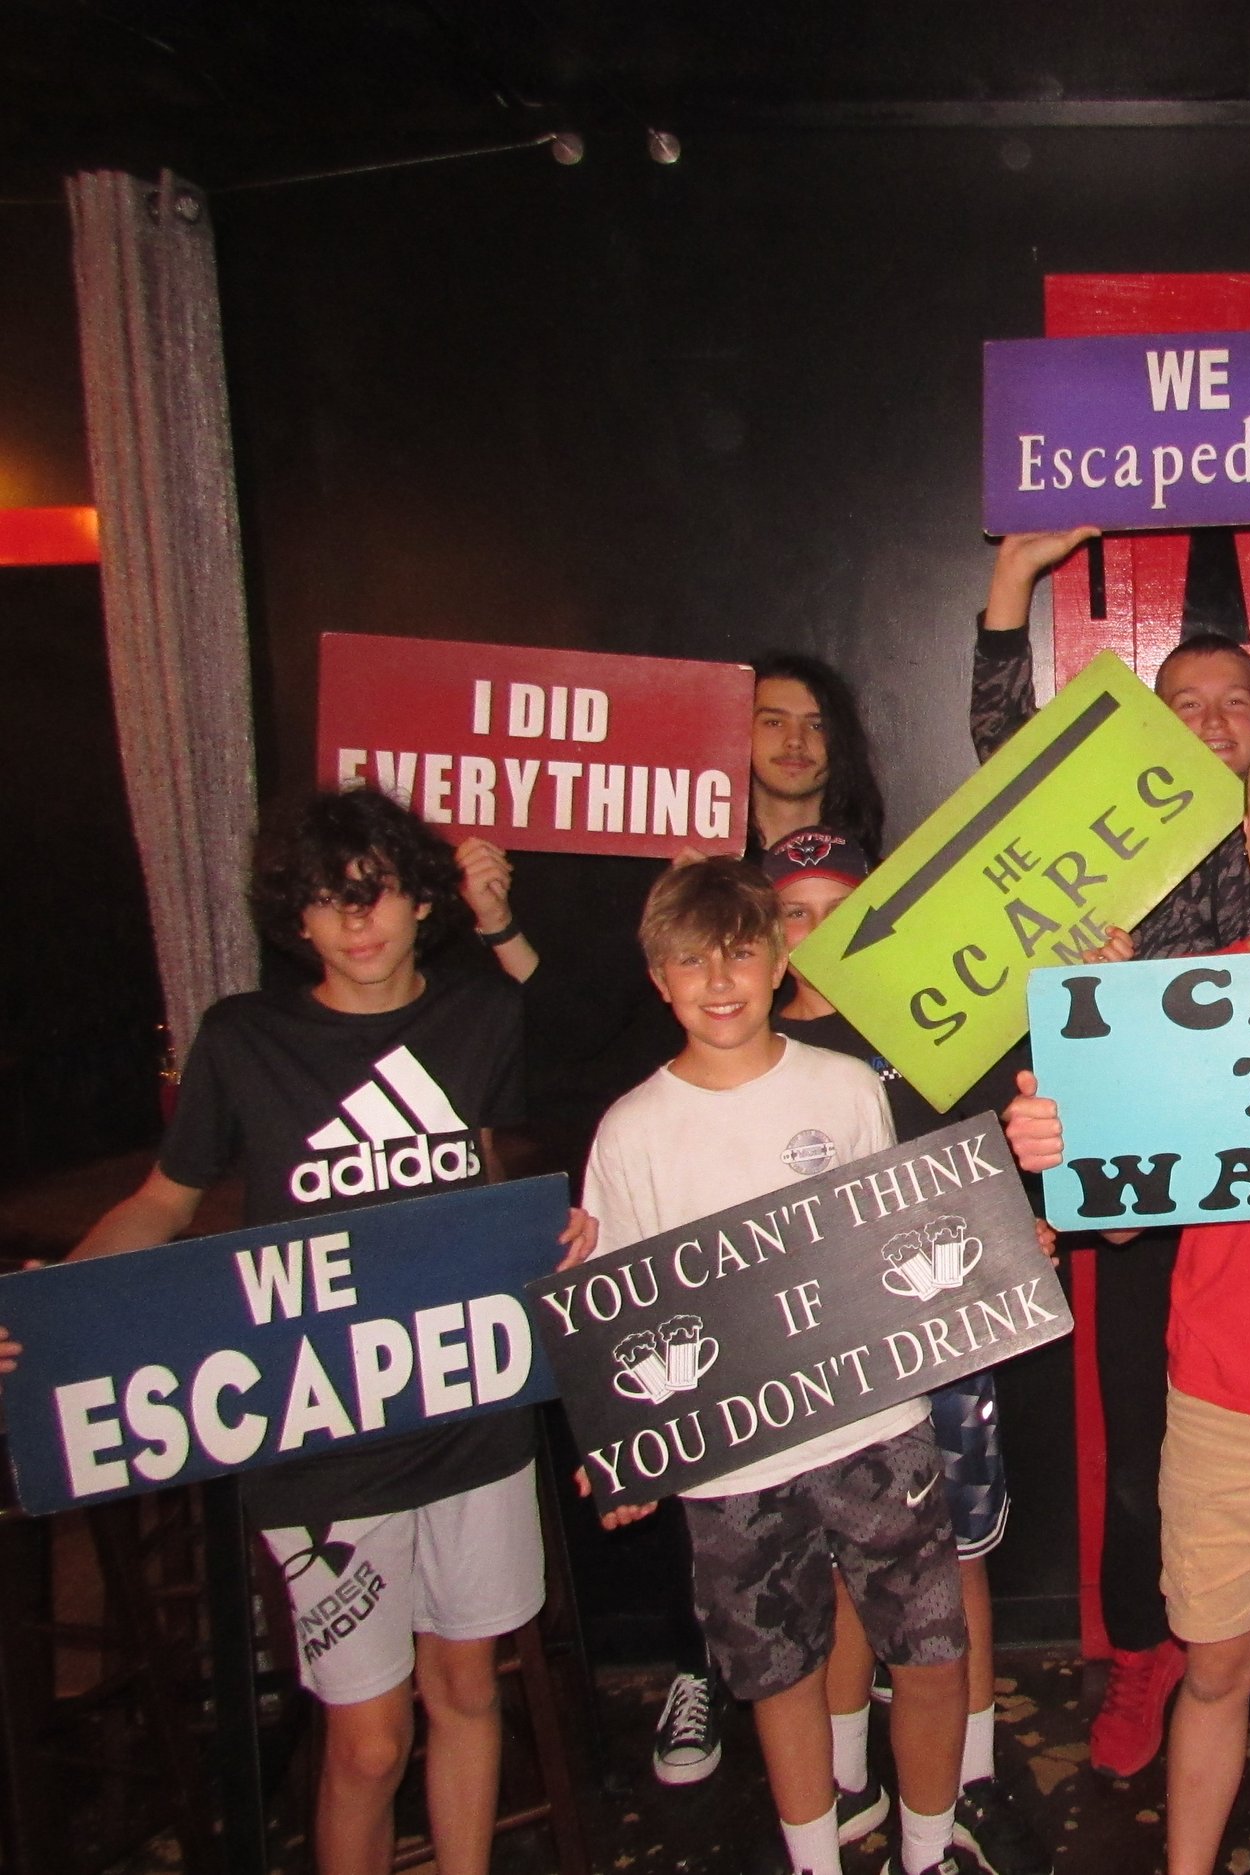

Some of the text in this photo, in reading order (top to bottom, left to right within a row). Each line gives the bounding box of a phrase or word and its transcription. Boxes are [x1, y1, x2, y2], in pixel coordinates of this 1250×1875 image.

[1146, 350, 1231, 412] WE
[472, 680, 609, 743] I DID
[982, 837, 1042, 894] HE
[910, 766, 1194, 1046] SCARES
[1061, 976, 1112, 1040] I
[291, 1134, 481, 1202] adidas
[542, 1133, 1004, 1337] YOU CAN'T THINK
[234, 1231, 358, 1326] WE
[774, 1279, 823, 1337] IF
[54, 1293, 534, 1498] ESCAPED
[588, 1277, 1058, 1495] YOU DON'T DRINK
